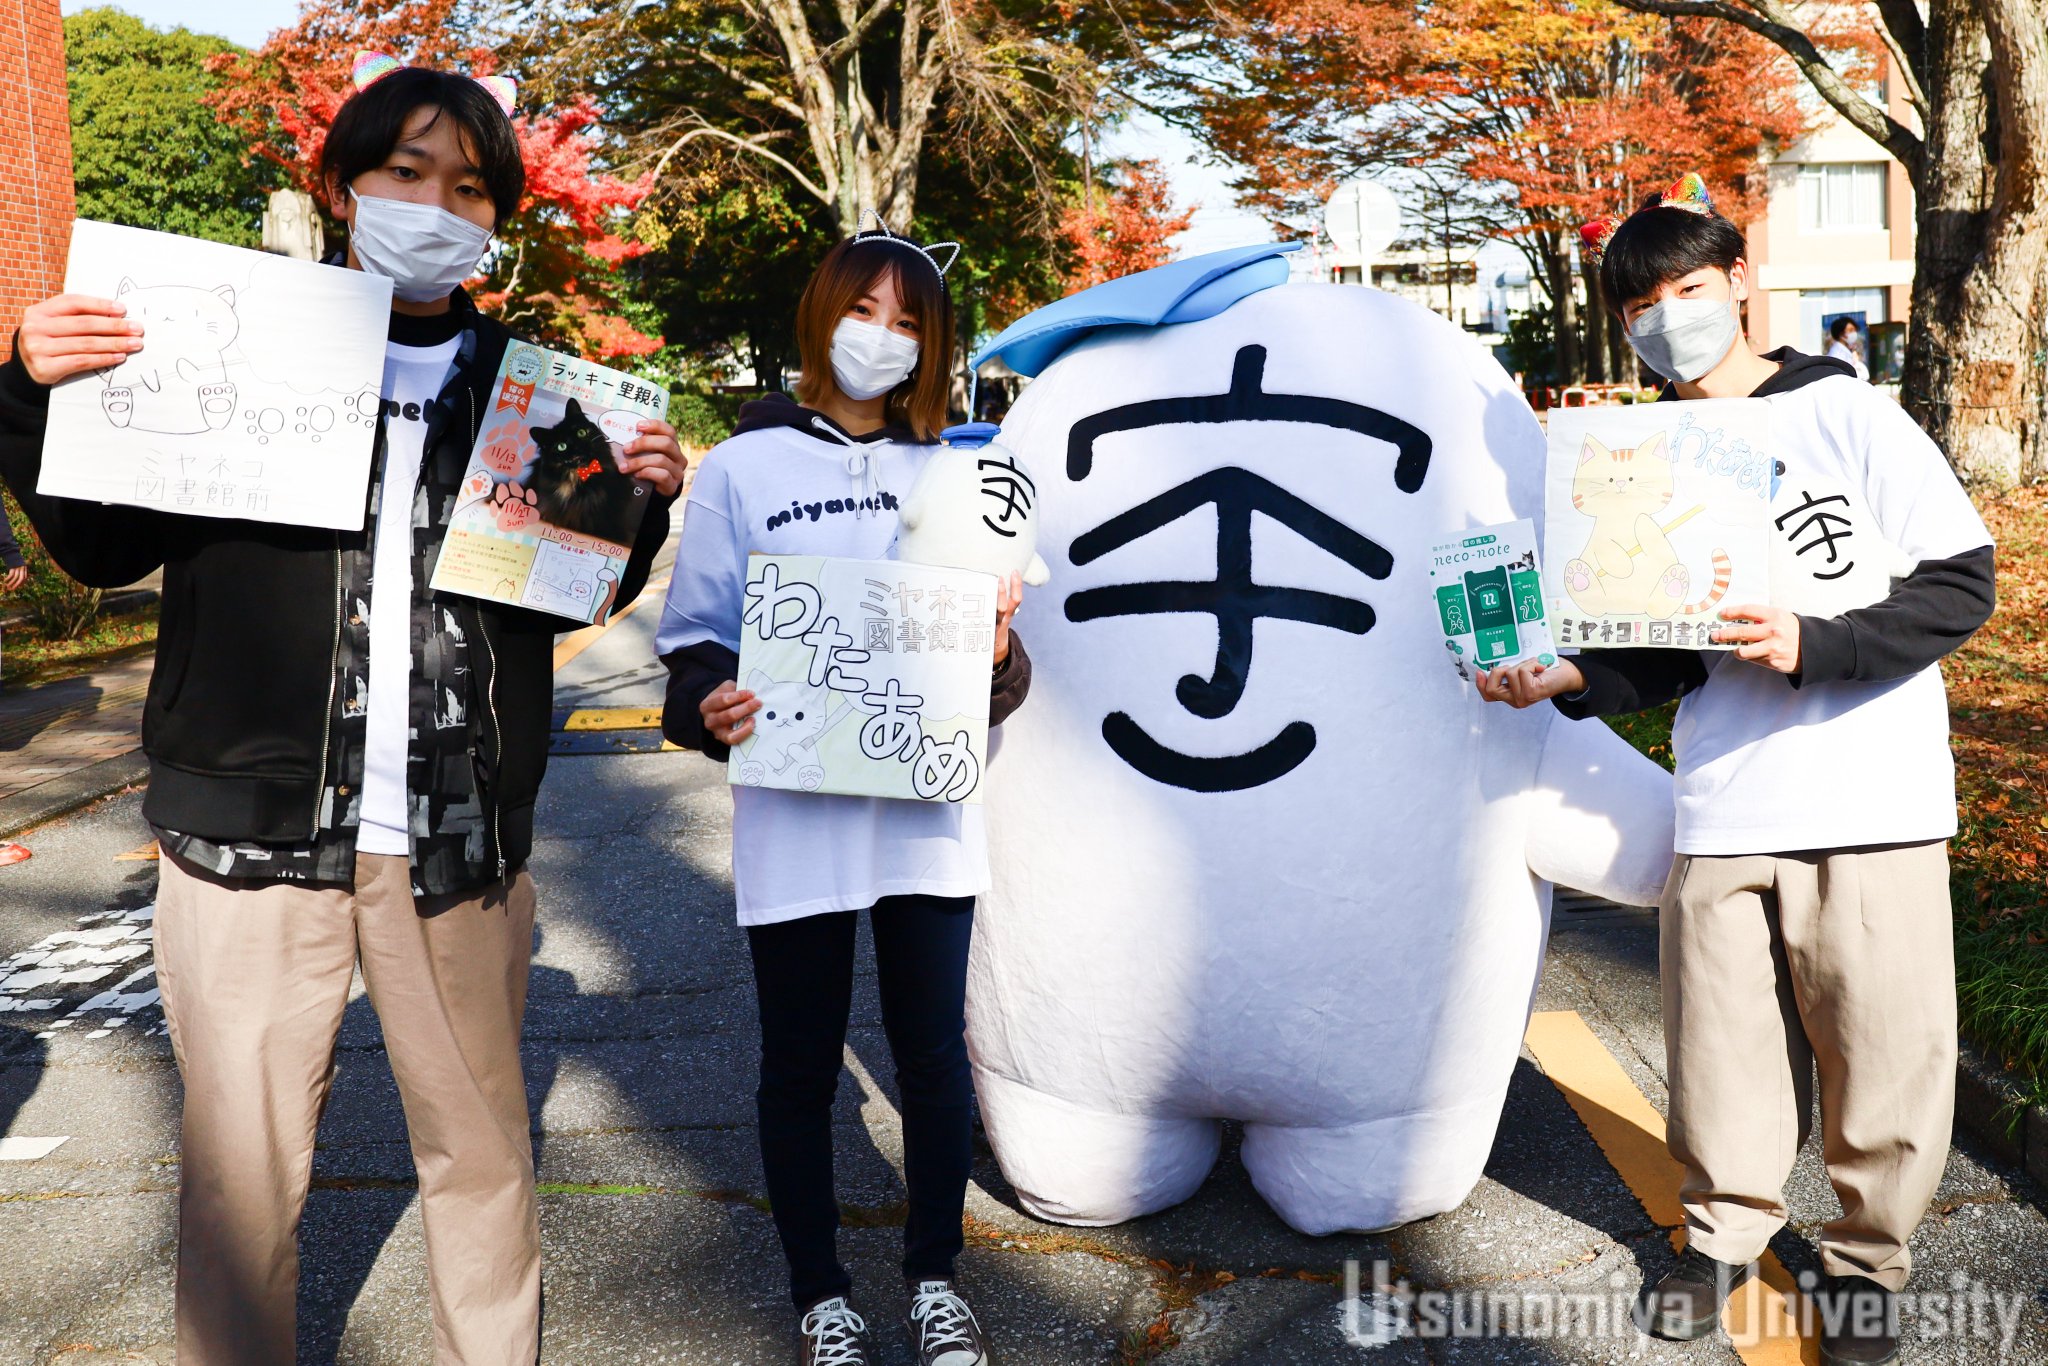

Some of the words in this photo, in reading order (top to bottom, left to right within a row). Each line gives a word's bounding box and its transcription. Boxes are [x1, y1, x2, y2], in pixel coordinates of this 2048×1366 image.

[552, 362, 662, 410] ラッキー里親会
[141, 448, 264, 478] ミヤネコ
[491, 445, 516, 464] 11/13
[135, 475, 272, 512] 図書館前
[505, 502, 531, 518] 11/27
[1434, 545, 1510, 566] neco-note
[859, 578, 985, 620] ミヤネコ
[863, 617, 992, 654] 図書館前
[742, 563, 979, 803] わたあめ
